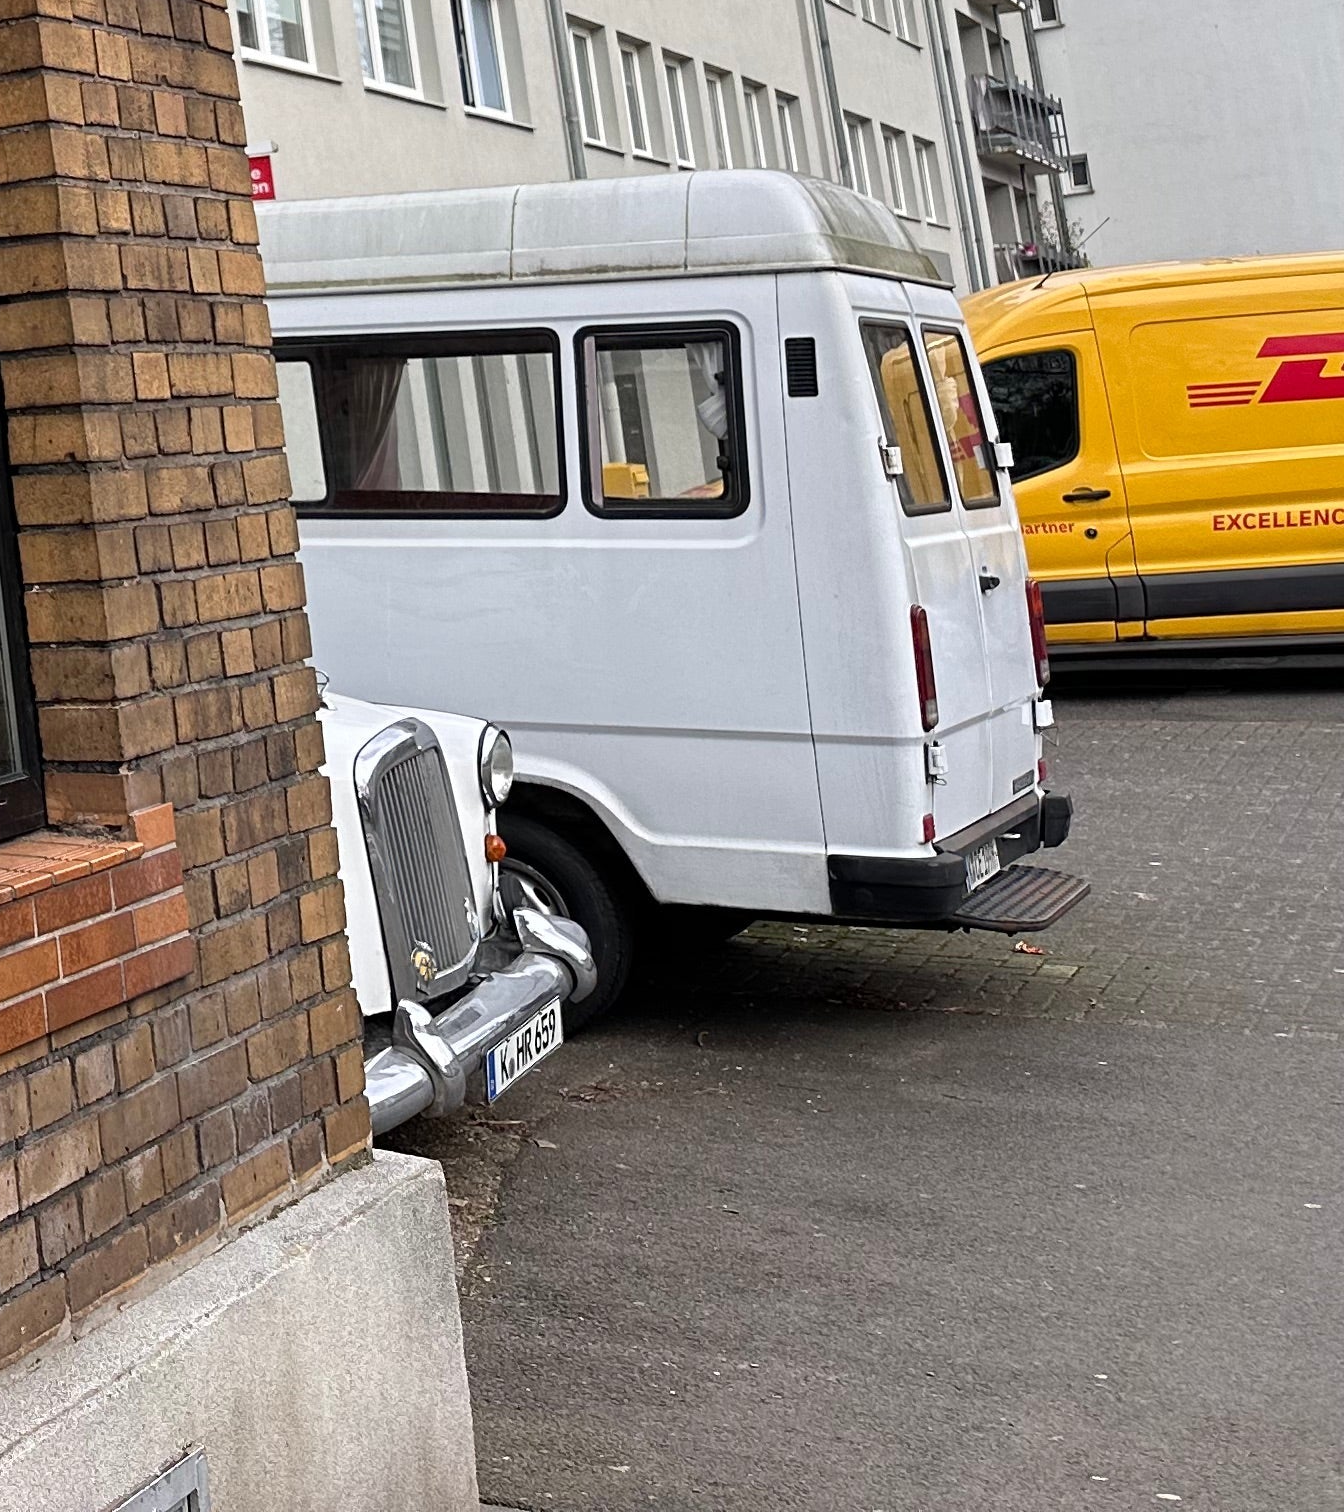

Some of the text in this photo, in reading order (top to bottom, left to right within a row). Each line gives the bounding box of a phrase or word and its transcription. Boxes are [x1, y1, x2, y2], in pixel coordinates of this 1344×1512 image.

[500, 1008, 556, 1085] K HR 659
